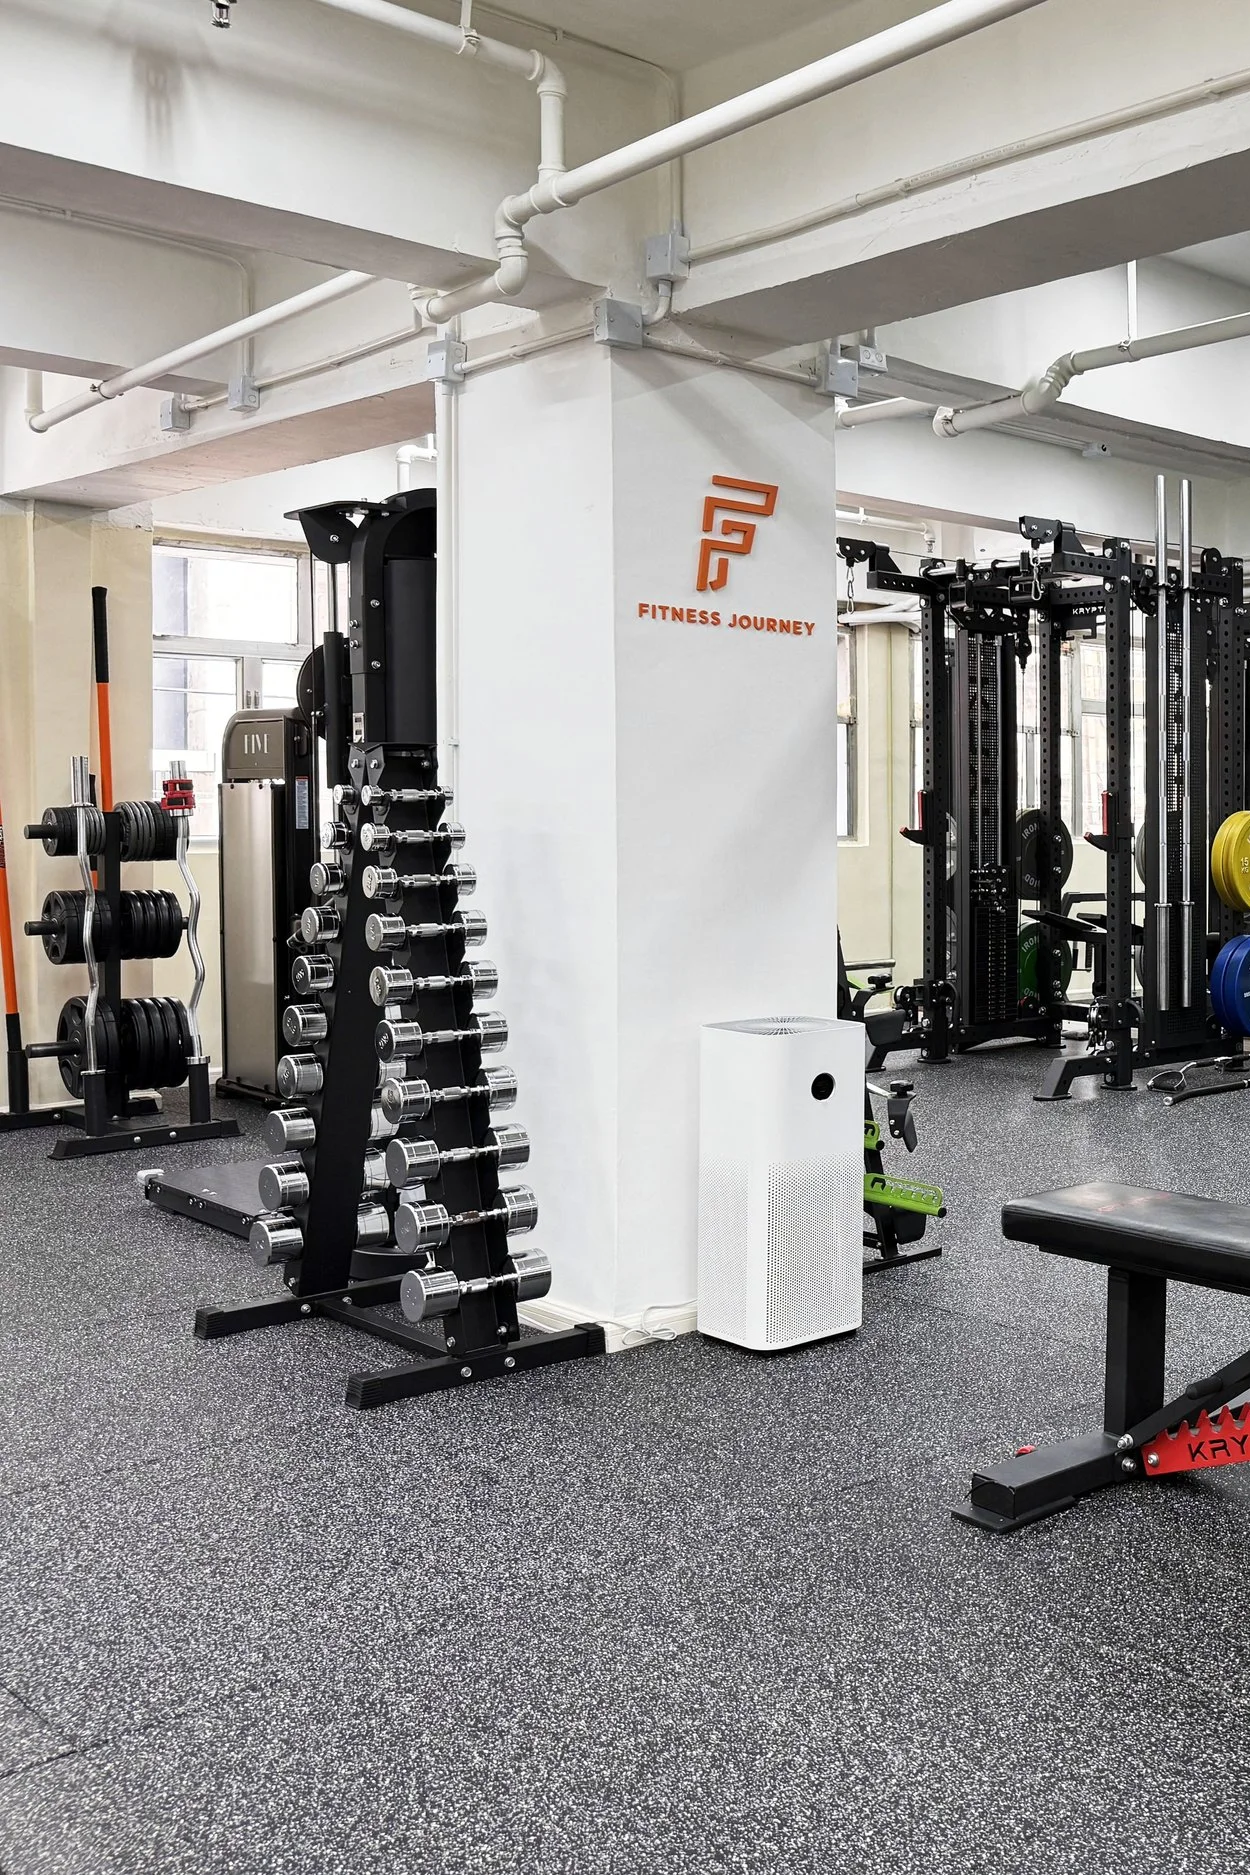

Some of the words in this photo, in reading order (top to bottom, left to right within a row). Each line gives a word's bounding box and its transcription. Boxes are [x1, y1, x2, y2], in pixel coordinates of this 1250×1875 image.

[637, 603, 721, 625] FITNESS
[728, 614, 815, 636] JOURNEY
[1072, 606, 1106, 615] KRYPT
